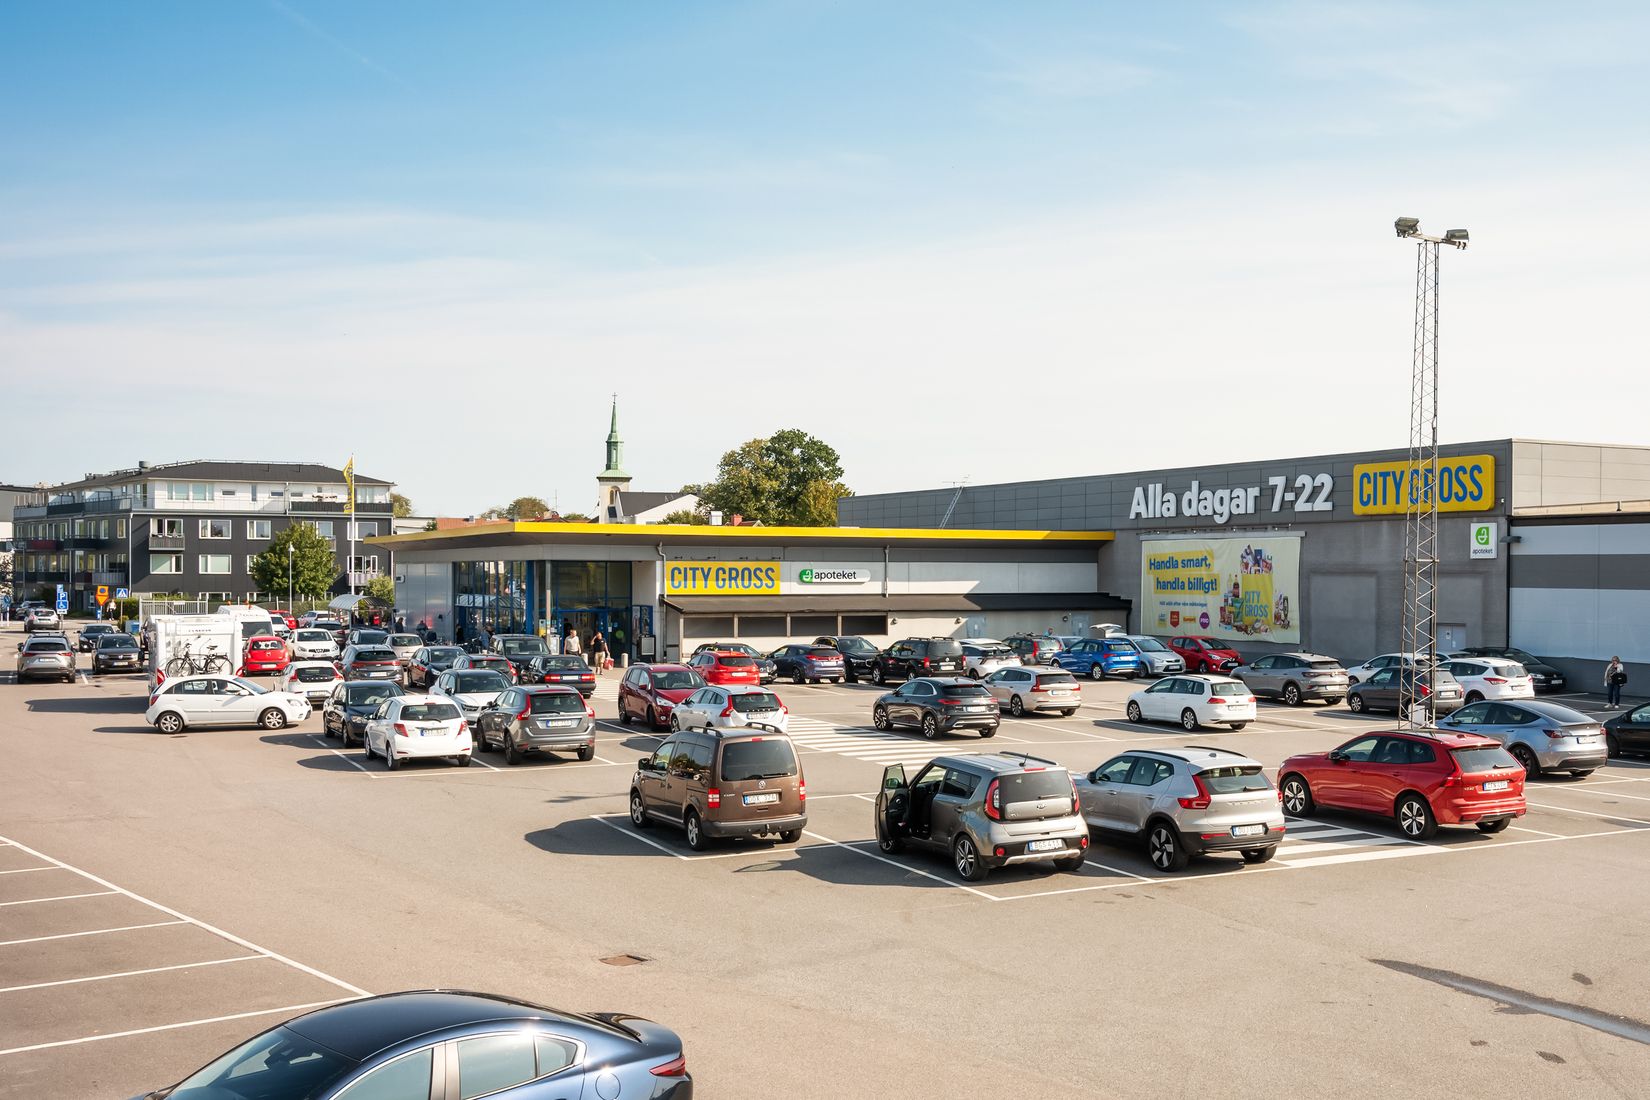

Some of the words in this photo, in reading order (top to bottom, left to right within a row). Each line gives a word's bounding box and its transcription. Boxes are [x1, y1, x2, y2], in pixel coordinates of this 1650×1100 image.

[1359, 470, 1405, 507] CITY
[1130, 483, 1177, 519] Alla
[1182, 480, 1260, 524] dagar
[1268, 473, 1333, 513] 7-22
[1149, 555, 1179, 570] Handla
[1181, 555, 1211, 569] smart,
[670, 566, 713, 589] CITY
[715, 566, 775, 589] GROSS
[814, 570, 857, 581] apoteket
[1156, 577, 1185, 591] handla
[1187, 577, 1217, 593] billigt!
[1244, 590, 1260, 603] CITY
[1244, 604, 1269, 618] GROSS
